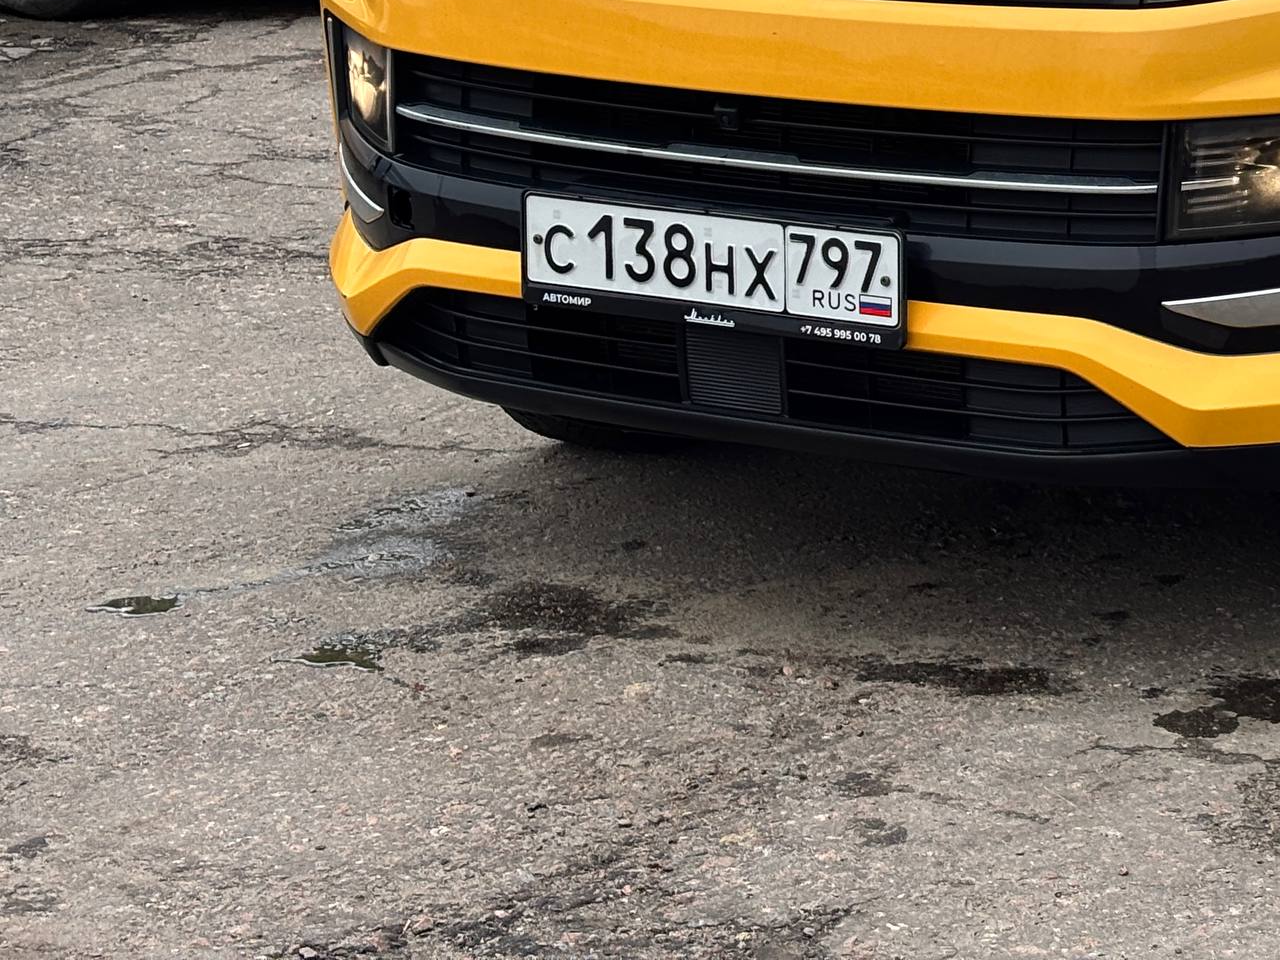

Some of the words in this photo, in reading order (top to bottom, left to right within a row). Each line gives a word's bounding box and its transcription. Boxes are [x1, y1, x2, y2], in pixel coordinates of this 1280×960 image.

[790, 233, 882, 293] 797
[542, 292, 592, 307] АВТОМИР
[812, 289, 857, 312] RUS
[800, 325, 812, 334] +7
[814, 326, 832, 337] 495
[834, 329, 852, 340] 995
[854, 331, 867, 342] 00
[869, 334, 882, 344] 78
